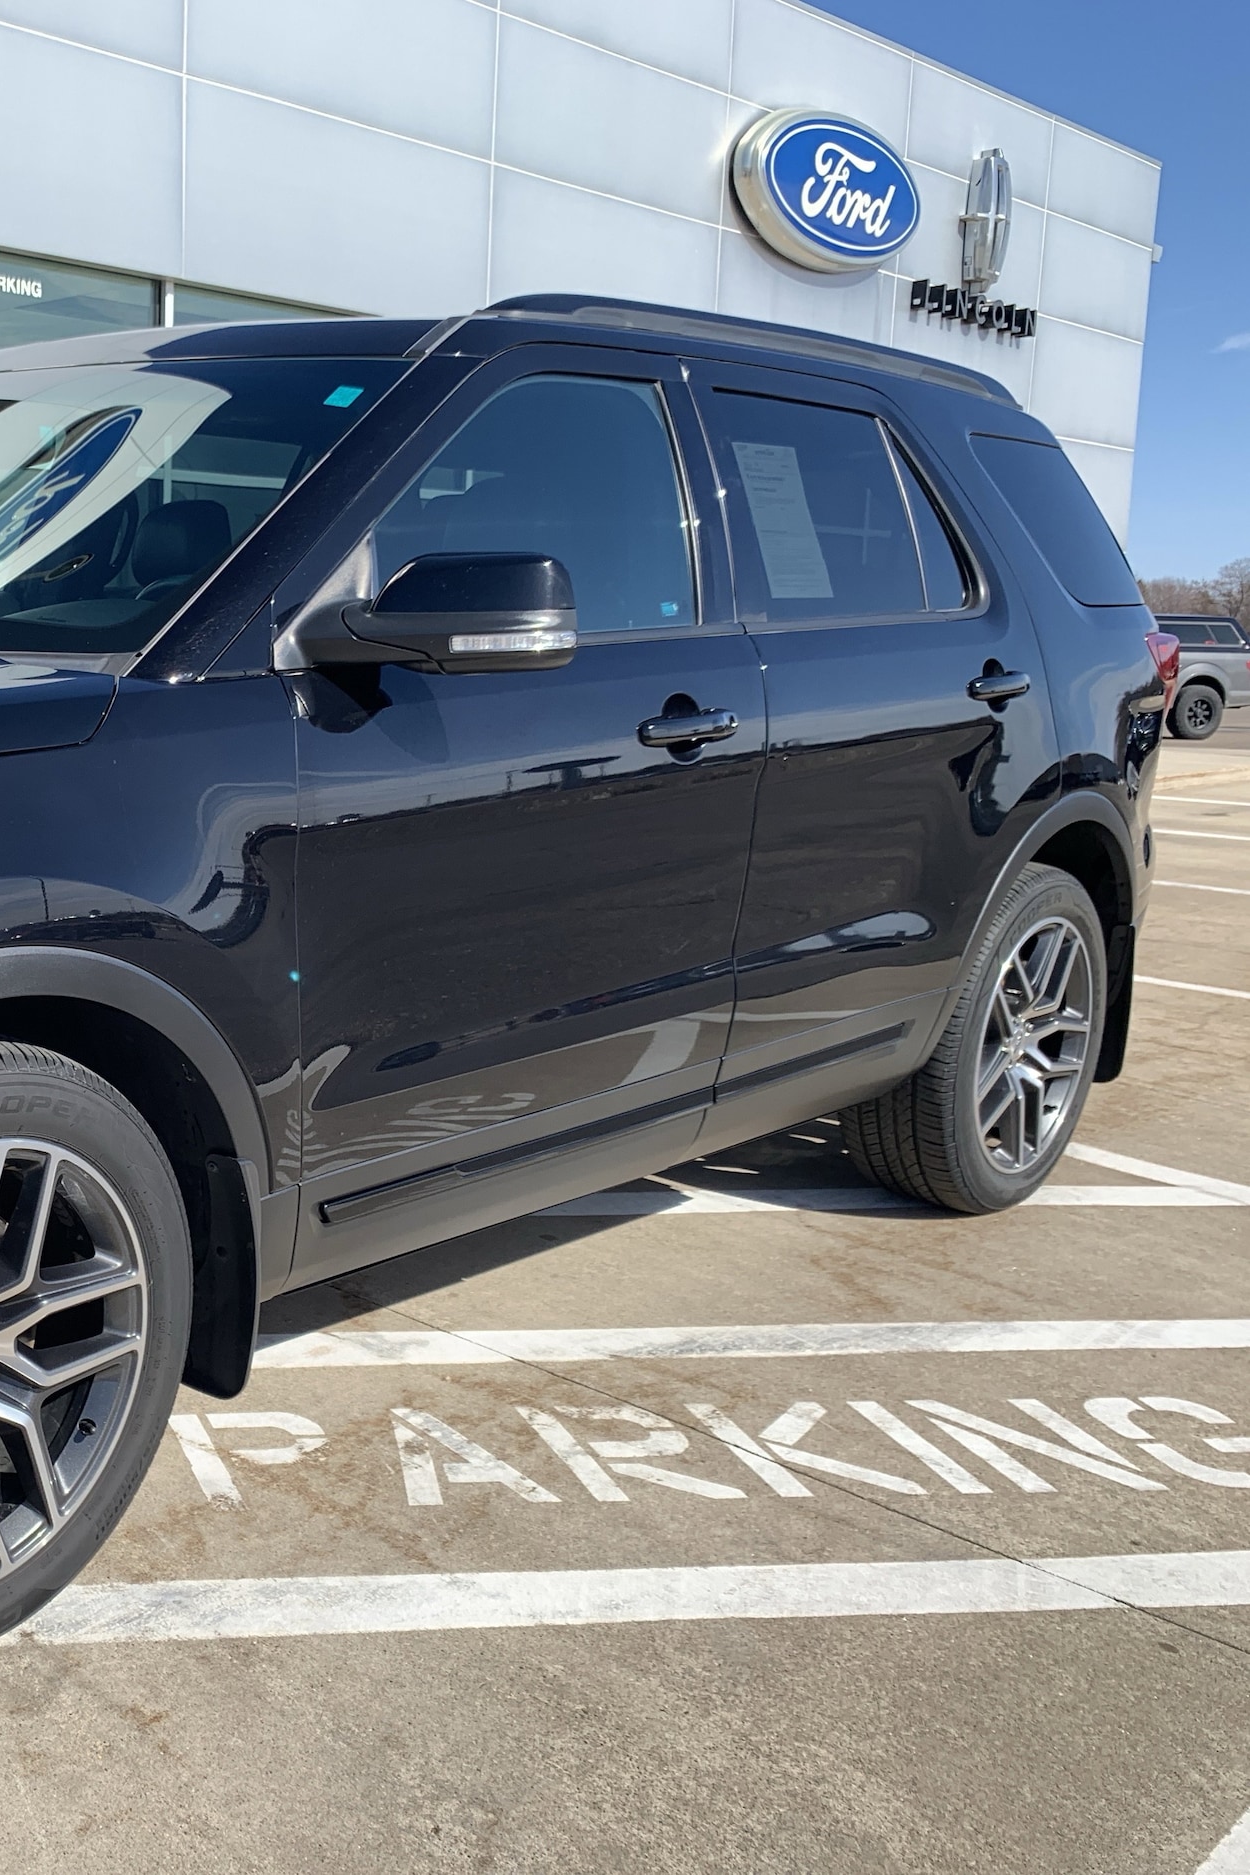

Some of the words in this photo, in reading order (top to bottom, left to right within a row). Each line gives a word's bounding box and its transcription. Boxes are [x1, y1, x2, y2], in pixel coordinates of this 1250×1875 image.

[801, 141, 896, 238] Ford
[911, 279, 1038, 338] LINCOLN
[168, 1396, 1250, 1511] PARKING
